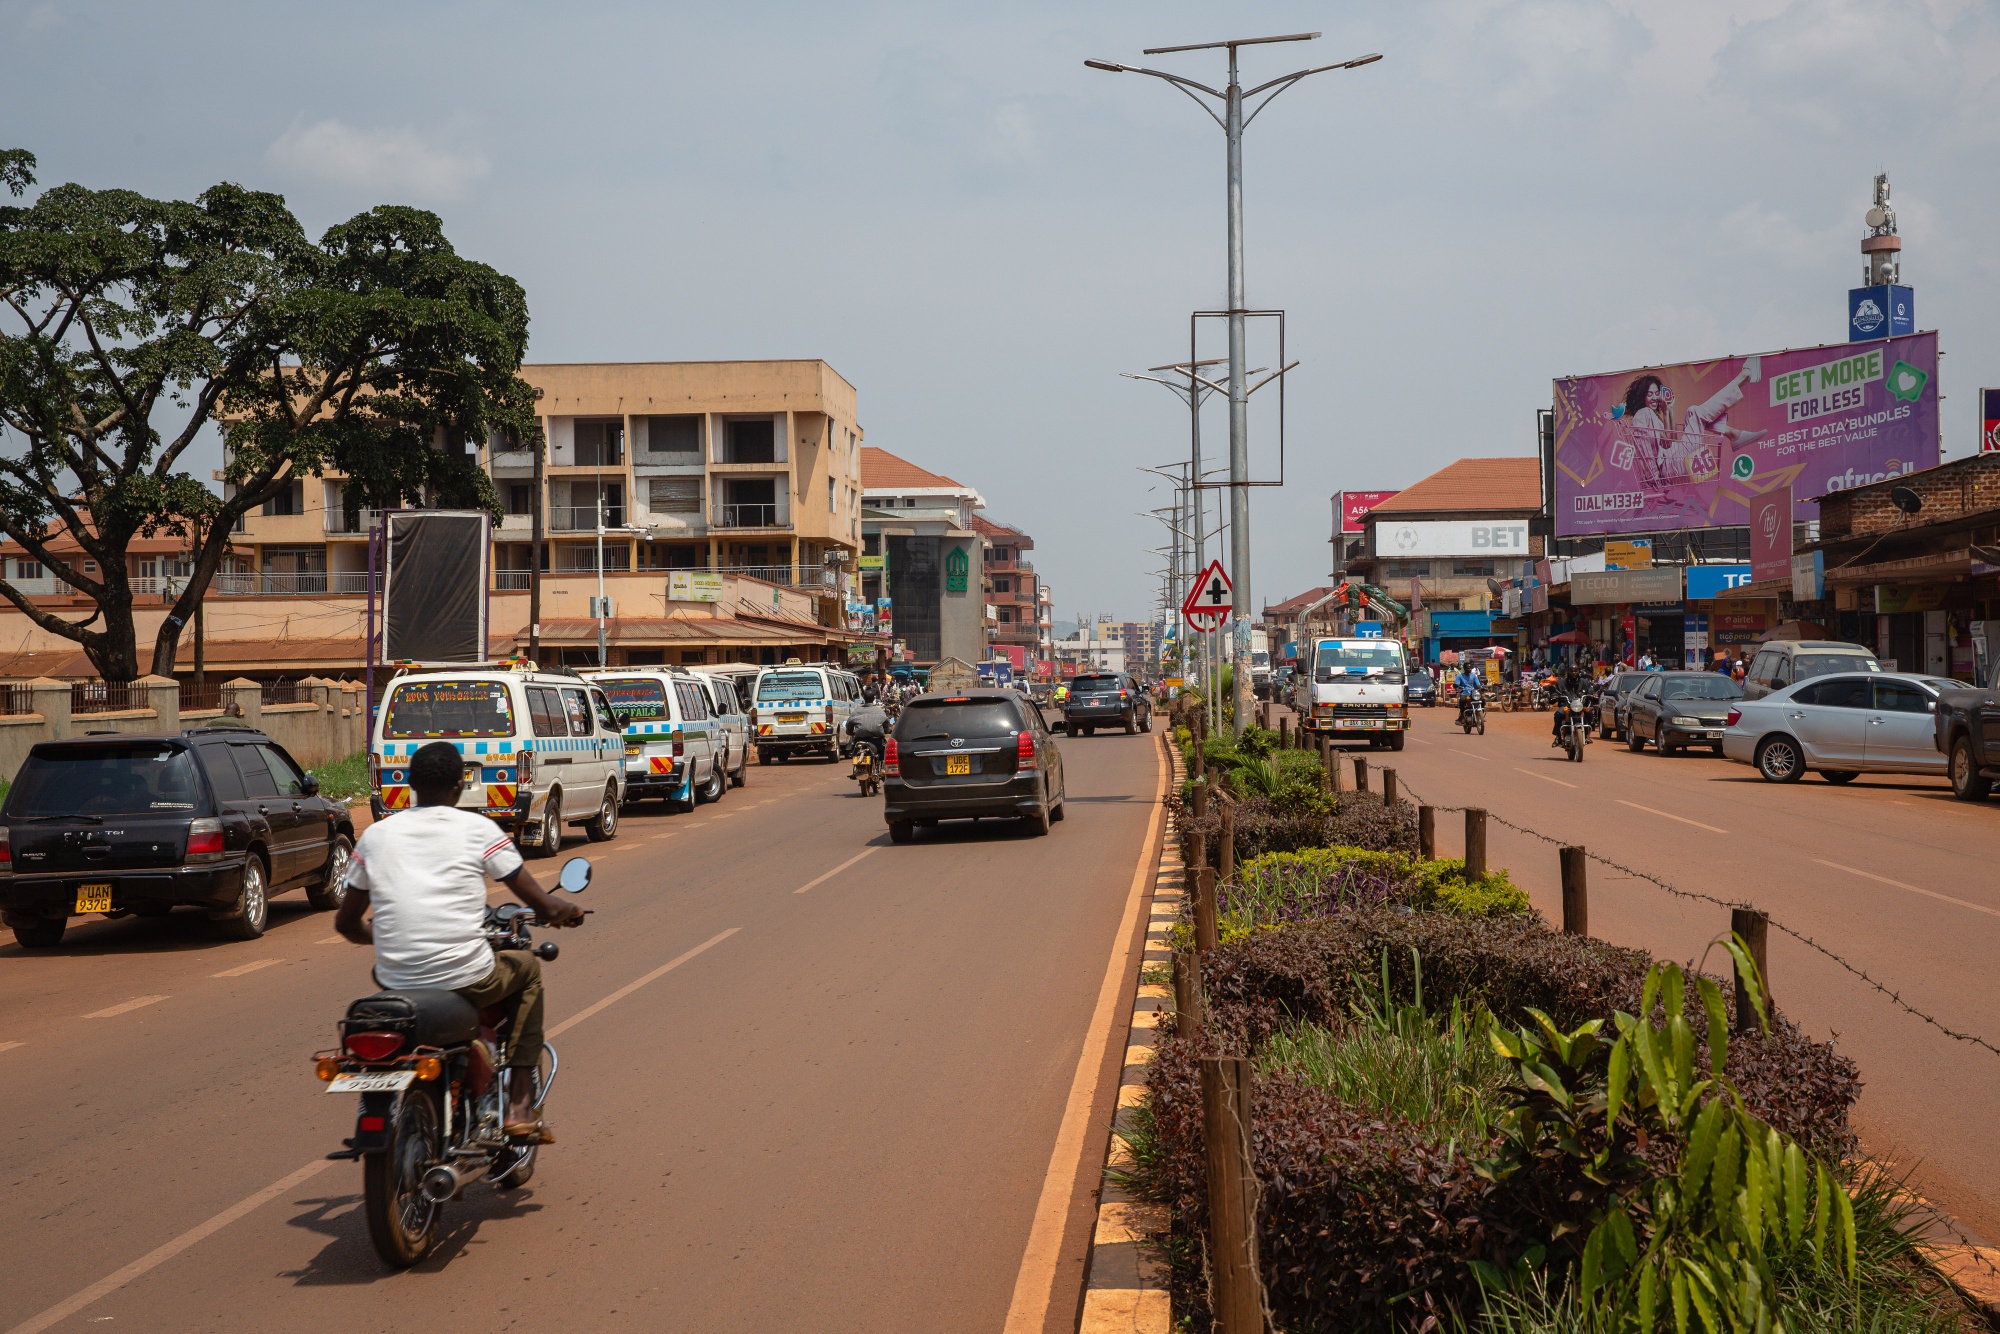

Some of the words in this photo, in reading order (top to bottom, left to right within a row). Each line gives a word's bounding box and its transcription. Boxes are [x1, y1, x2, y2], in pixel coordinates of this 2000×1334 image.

[1775, 369, 1815, 400] GET
[1821, 352, 1881, 390] MORE
[1791, 398, 1819, 420] FOR
[1823, 387, 1861, 412] LESS
[1758, 438, 1775, 450] THE
[1778, 429, 1809, 445] BEST
[1812, 422, 1846, 438] DATA
[1849, 405, 1911, 430] BUNDLES
[1776, 445, 1795, 456] FOR
[1799, 441, 1816, 452] THE
[1818, 435, 1842, 448] BEST
[1844, 427, 1878, 442] VALUE
[1691, 448, 1716, 474] 4G
[1576, 496, 1601, 511] DIAL
[1471, 526, 1525, 548] BET
[947, 575, 968, 591] 82
[1577, 576, 1619, 590] TECNO
[1732, 616, 1754, 624] airtel
[630, 707, 657, 717] FAILS
[384, 755, 409, 764] UAU
[953, 756, 968, 765] UBE
[949, 764, 968, 774] 172F
[87, 886, 109, 899] UAN
[79, 899, 108, 911] 937G
